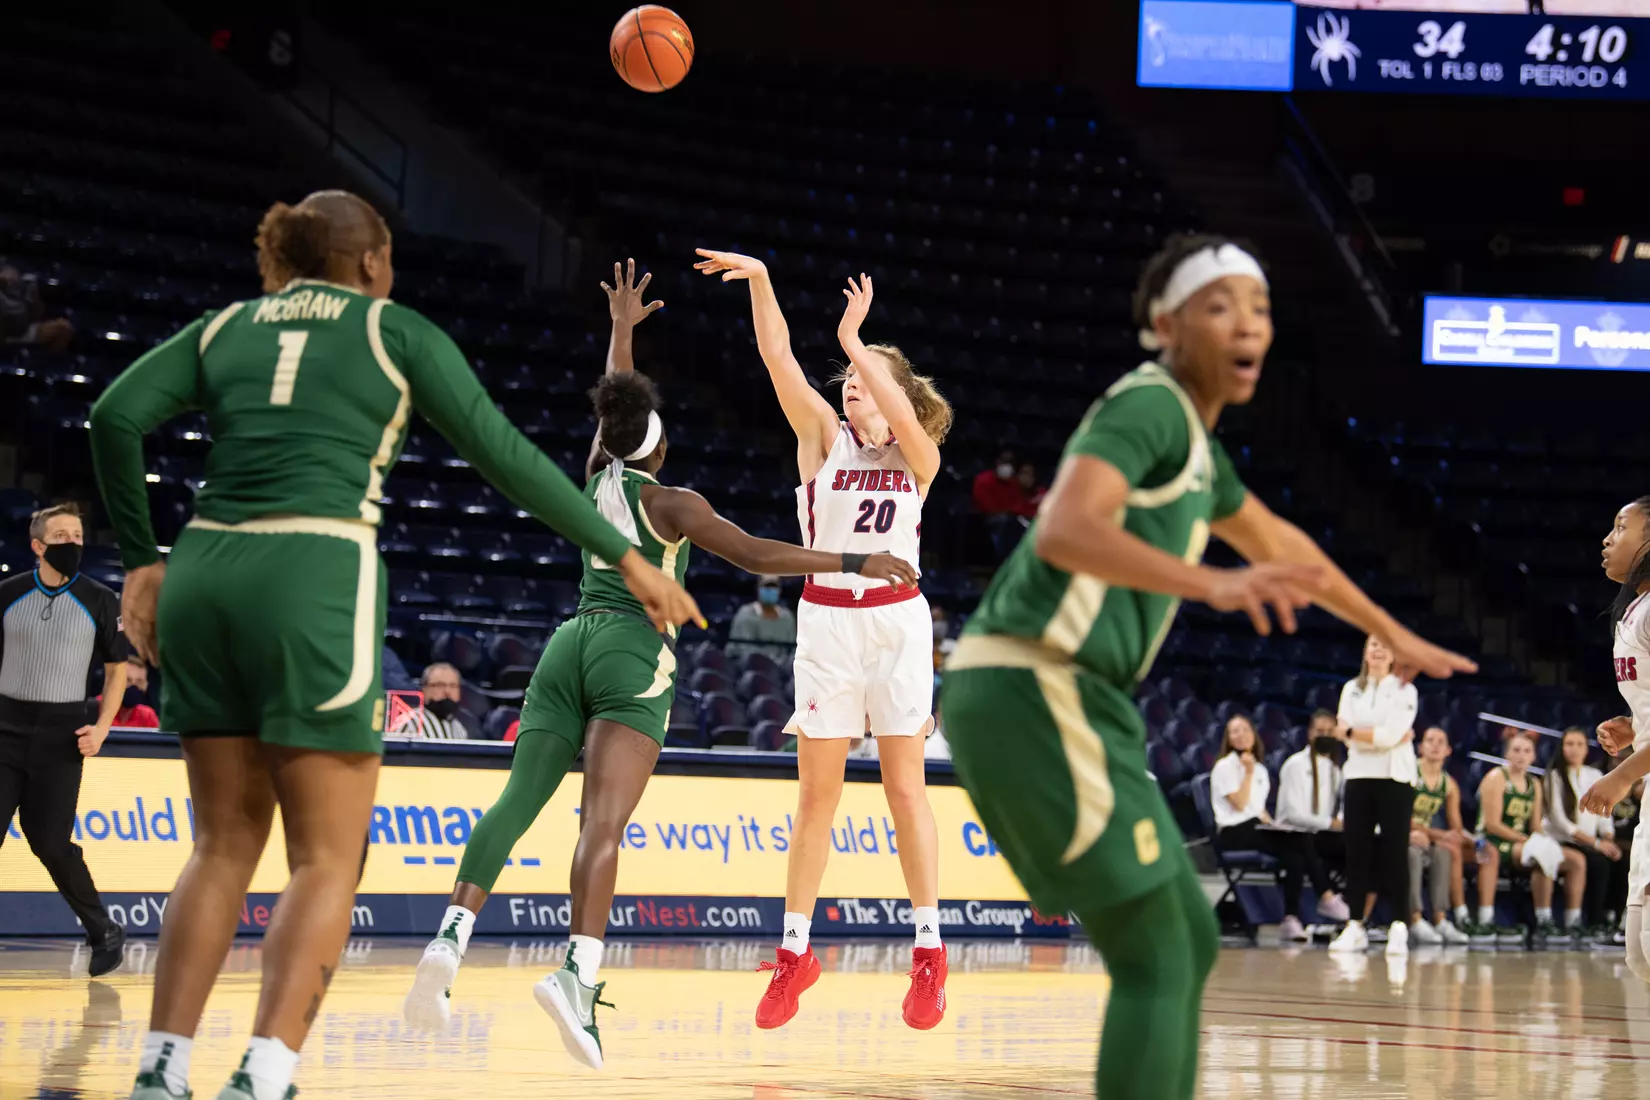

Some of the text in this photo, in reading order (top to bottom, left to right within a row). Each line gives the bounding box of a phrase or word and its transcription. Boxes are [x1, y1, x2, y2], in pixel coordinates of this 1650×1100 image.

[1413, 20, 1466, 58] 34
[1525, 24, 1628, 62] 4:10
[1377, 59, 1415, 79] TOL
[1423, 61, 1433, 79] 1
[1442, 61, 1478, 81] FLS
[1520, 64, 1628, 88] PERIOD 4
[269, 330, 309, 405] 1
[832, 469, 912, 493] SPIDERS
[853, 499, 897, 533] 20
[656, 823, 731, 864] way
[738, 815, 765, 851] it
[770, 815, 880, 854] suld
[509, 898, 762, 928] FindurNest.com
[837, 899, 879, 925] The
[965, 901, 1024, 934] Group
